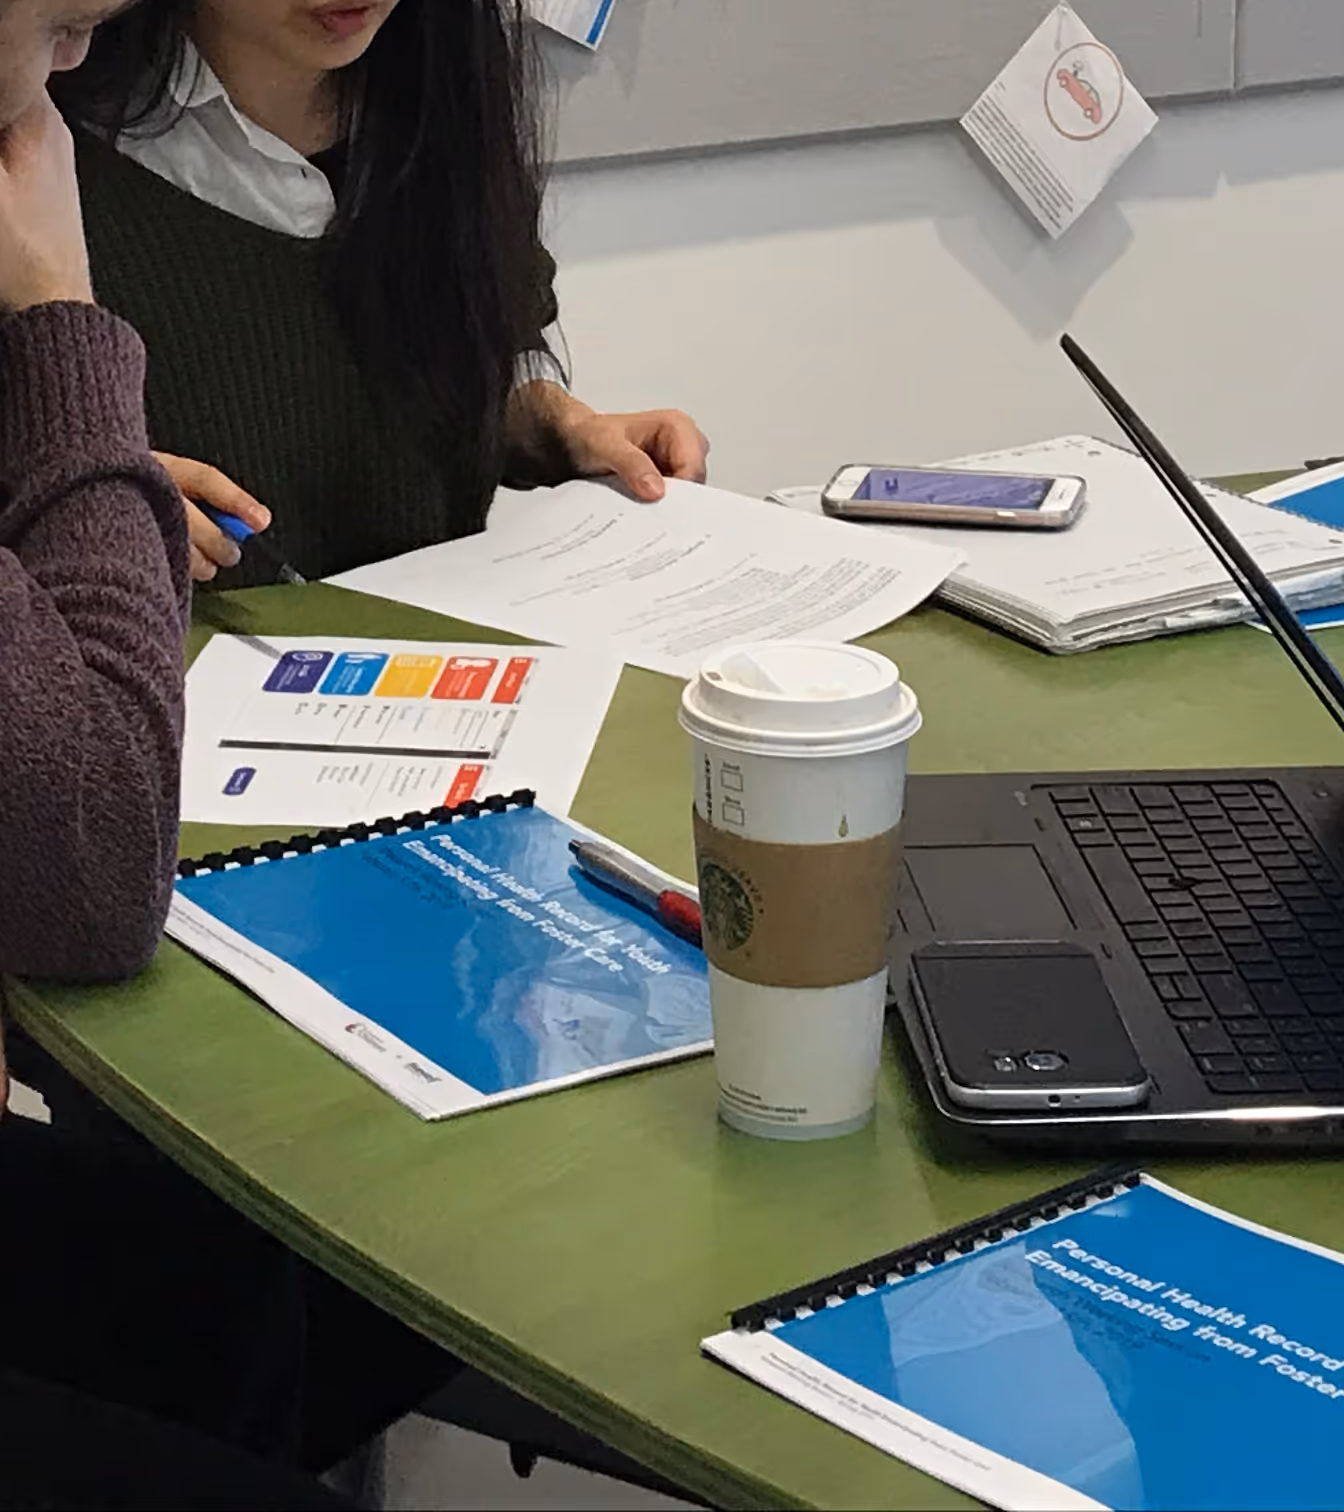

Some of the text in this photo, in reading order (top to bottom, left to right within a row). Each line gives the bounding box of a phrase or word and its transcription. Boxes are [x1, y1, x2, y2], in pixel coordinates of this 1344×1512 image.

[404, 840, 623, 973] Emancipating from Foster Care
[431, 834, 672, 974] Personal Health Record for Youth
[1026, 1250, 1190, 1331] Emancipating
[1193, 1324, 1257, 1359] from
[1053, 1238, 1166, 1292] Personal
[1162, 1288, 1246, 1330] Health
